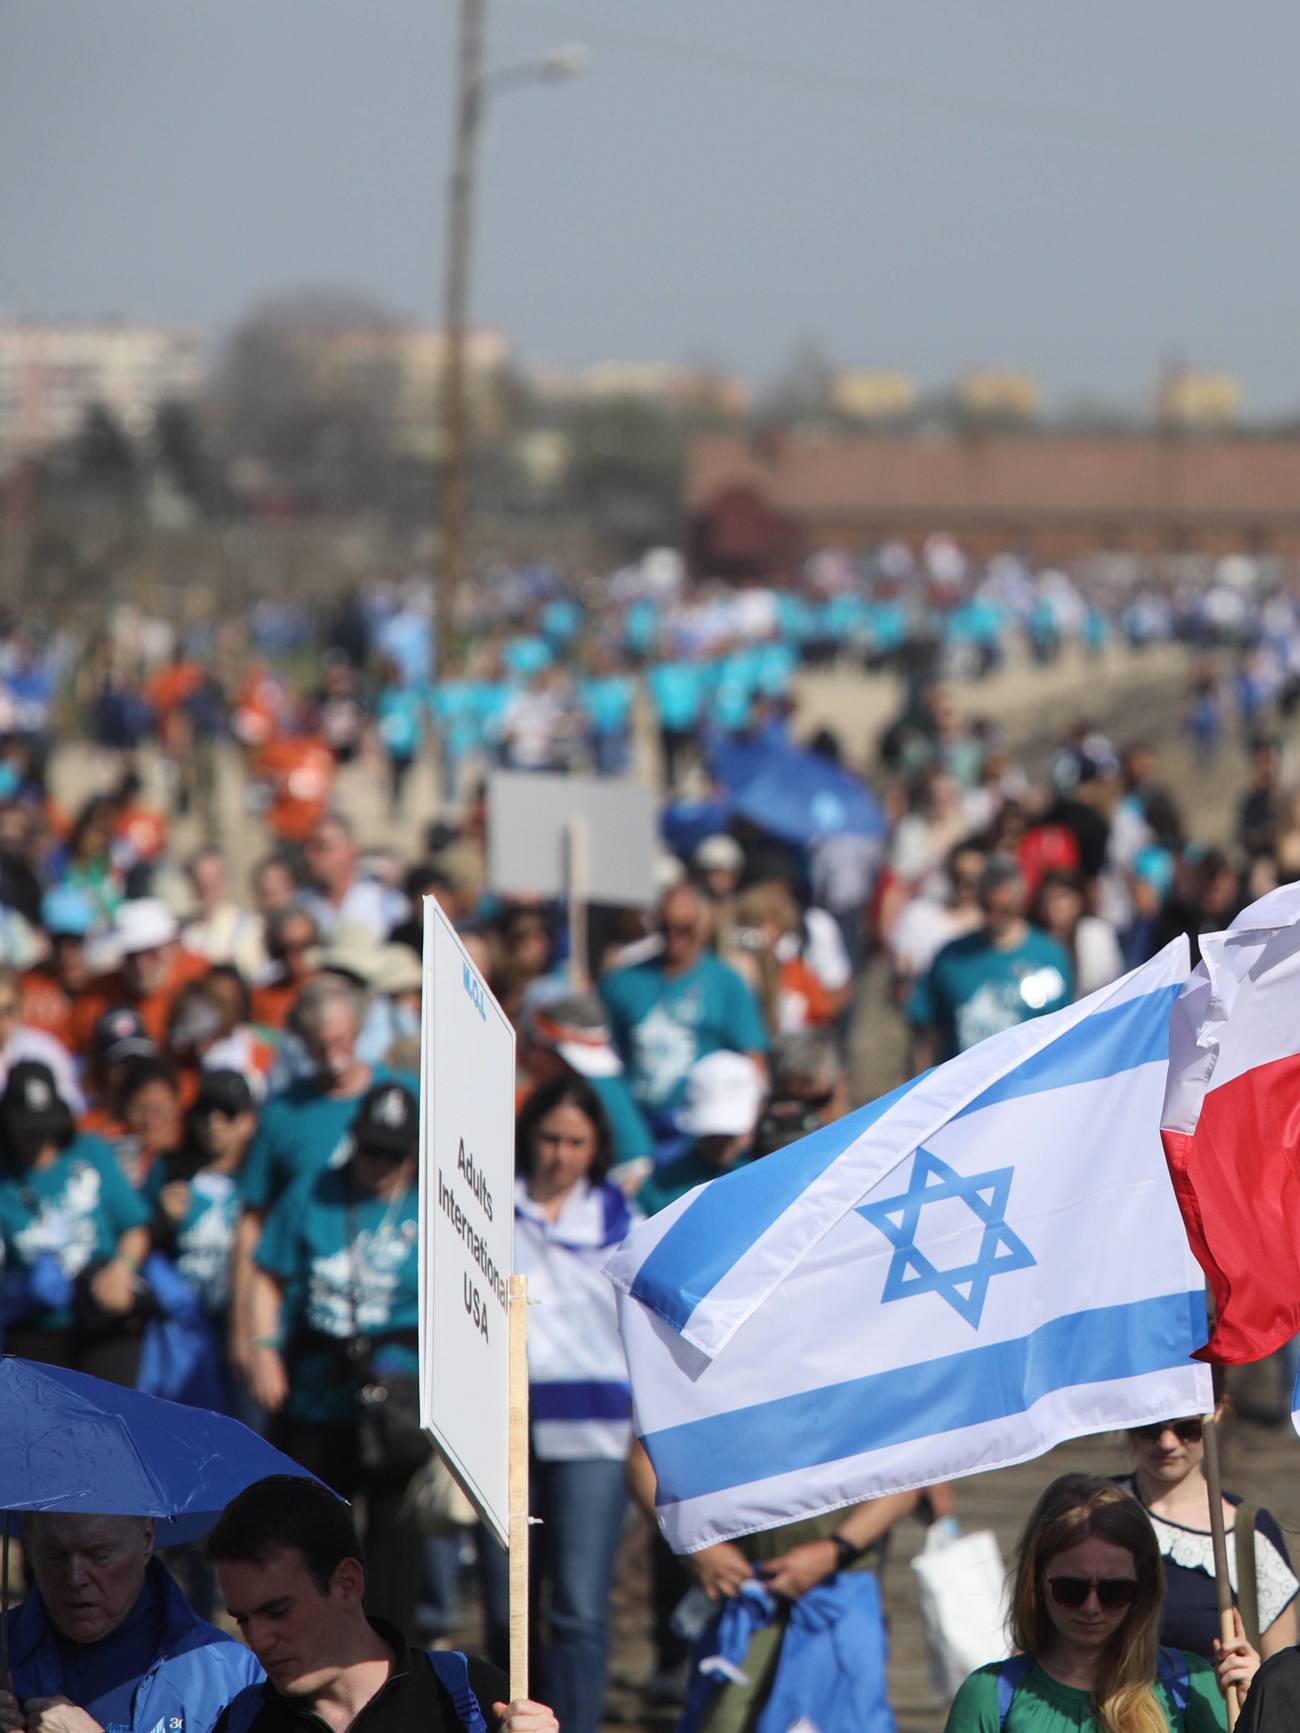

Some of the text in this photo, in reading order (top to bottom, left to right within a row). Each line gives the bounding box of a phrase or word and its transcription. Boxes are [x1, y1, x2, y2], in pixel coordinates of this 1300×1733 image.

[457, 1136, 493, 1223] Adults
[438, 1168, 509, 1315] International
[463, 1270, 489, 1345] USA
